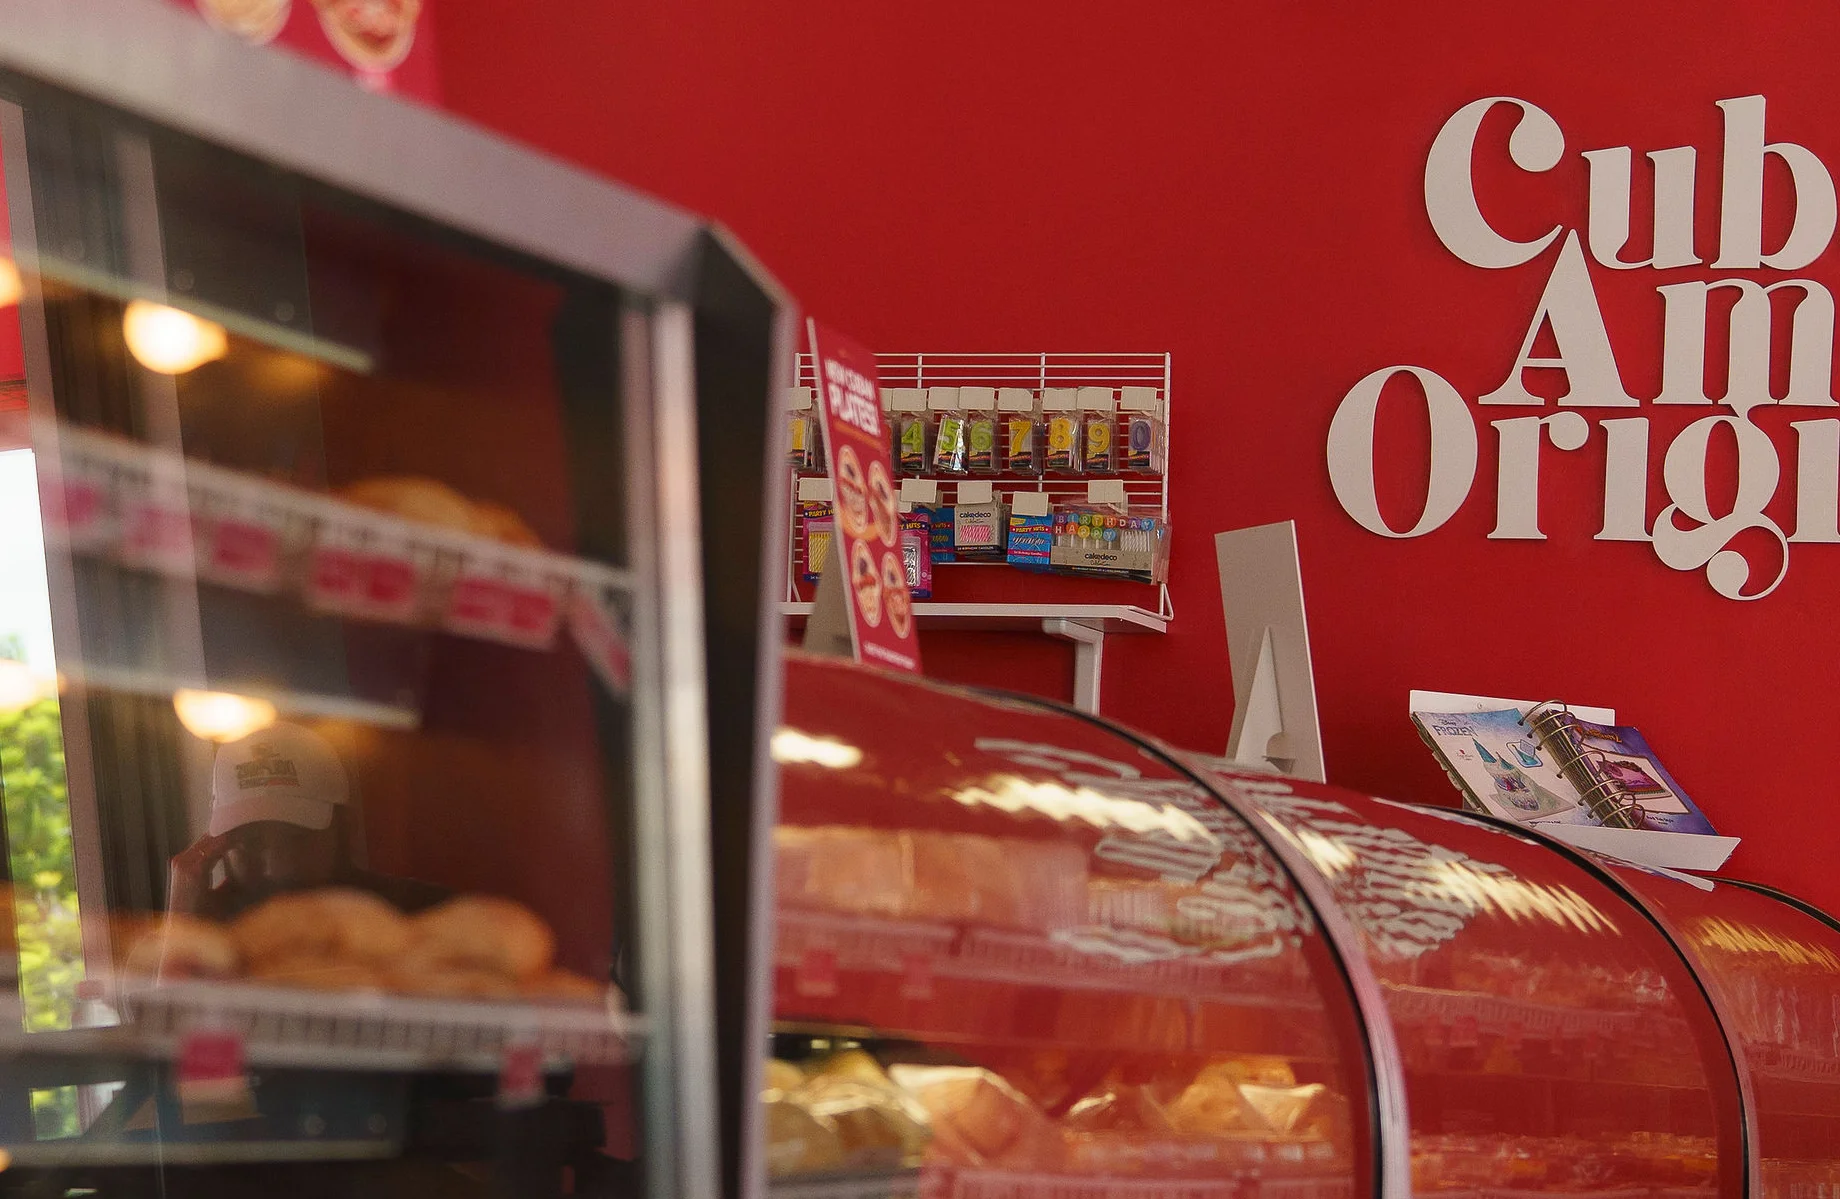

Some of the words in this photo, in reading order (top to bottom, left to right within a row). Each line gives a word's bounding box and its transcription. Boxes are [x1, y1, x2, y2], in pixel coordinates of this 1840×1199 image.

[1423, 94, 1839, 271] Cub
[1477, 228, 1840, 408] Am
[901, 420, 923, 451] 4
[939, 419, 961, 451] 5
[970, 420, 993, 451] 6
[1009, 420, 1032, 452] 7
[1049, 418, 1071, 450] 8
[1088, 422, 1110, 453] 9
[959, 511, 991, 520] cakedeco
[1054, 523, 1114, 539] HAPPY
[1057, 514, 1152, 529] BIRTHDAY
[1084, 552, 1118, 561] cakedeco
[1432, 725, 1478, 737] FROZEN
